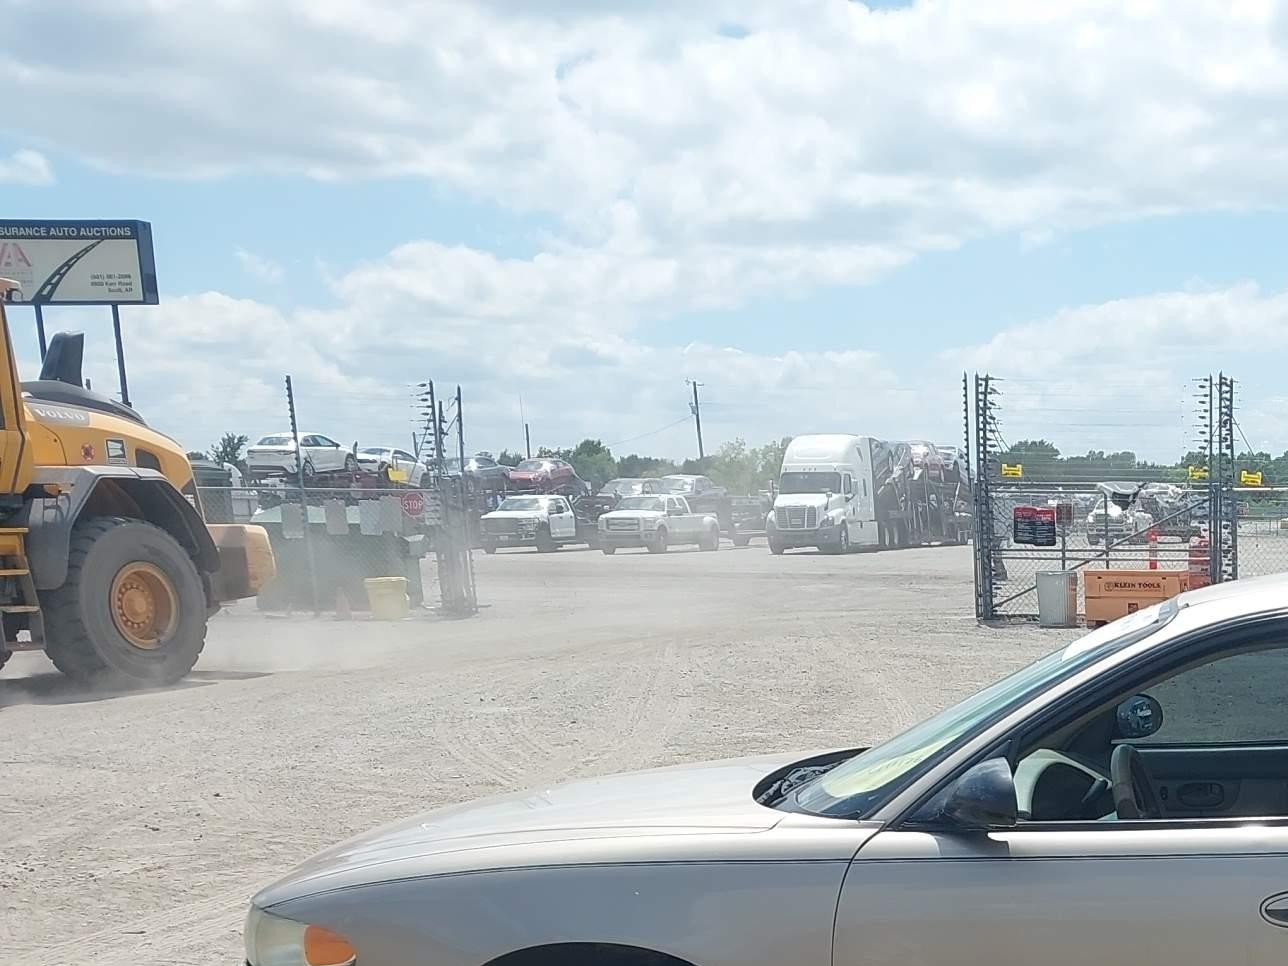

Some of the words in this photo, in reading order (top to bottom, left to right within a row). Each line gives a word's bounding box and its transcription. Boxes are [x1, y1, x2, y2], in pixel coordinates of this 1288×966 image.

[49, 227, 77, 236] AUTO
[80, 227, 131, 236] AUCTIONS
[34, 407, 85, 420] VOLVO
[404, 500, 424, 510] STOP
[1114, 581, 1136, 589] KLEIN
[1137, 581, 1161, 589] TOOLS
